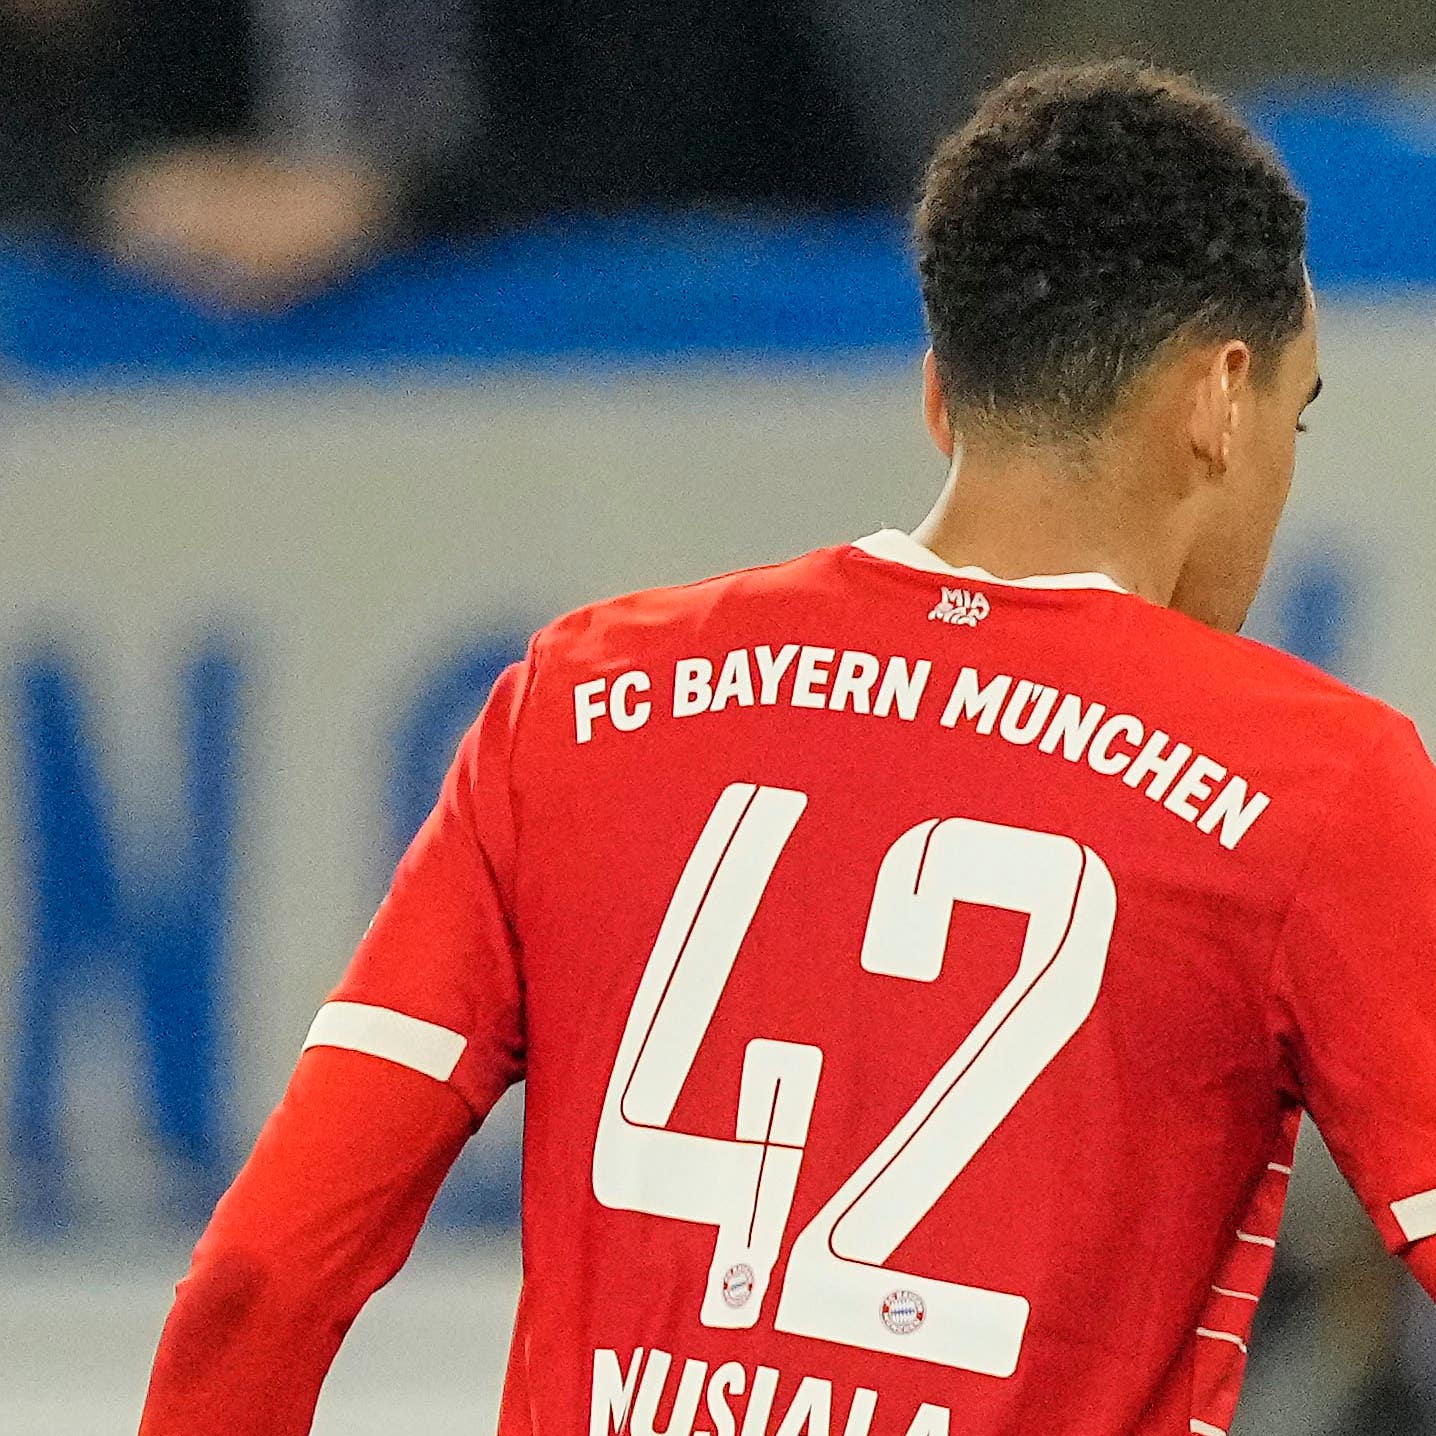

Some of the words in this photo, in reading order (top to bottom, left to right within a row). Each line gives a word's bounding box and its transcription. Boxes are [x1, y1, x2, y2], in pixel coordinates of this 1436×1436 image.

[573, 670, 651, 743] FC
[673, 645, 929, 720] BAYERN
[942, 668, 1270, 850] MÜNCHEN
[591, 782, 1117, 1378] 42
